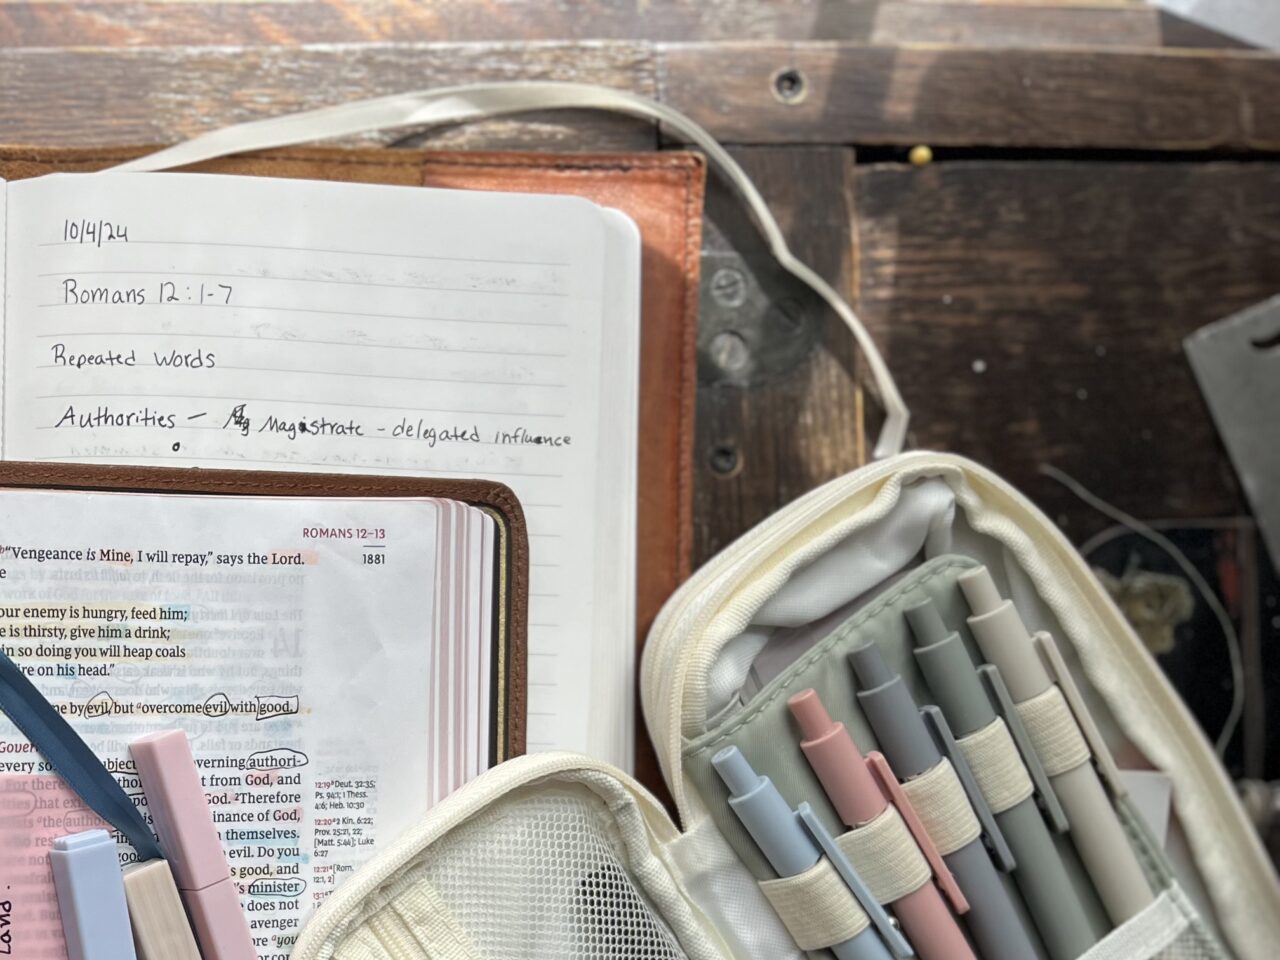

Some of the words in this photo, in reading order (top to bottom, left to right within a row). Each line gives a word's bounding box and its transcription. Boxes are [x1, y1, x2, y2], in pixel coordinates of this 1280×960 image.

[64, 219, 128, 248] 10/4/24
[62, 278, 145, 305] Romans
[51, 343, 136, 369] Repeated
[55, 405, 176, 429] Authorities
[392, 417, 480, 447] delegated
[495, 427, 571, 446] influence
[302, 527, 353, 539] ROMANS
[355, 528, 386, 540] 12–13
[86, 547, 97, 562] is
[99, 548, 134, 565] Mine,
[137, 550, 143, 563] I
[145, 549, 169, 563] will
[171, 550, 214, 567] repay,”
[216, 554, 244, 567] says
[246, 552, 269, 565] the
[271, 552, 305, 566] Lord.
[363, 553, 386, 565] 1881
[22, 607, 68, 622] enemy
[69, 605, 80, 619] is
[81, 605, 129, 623] hungry,
[130, 606, 158, 620] feed
[158, 607, 188, 623] him;
[226, 827, 301, 841] themselves.
[228, 845, 255, 859] evil.
[256, 846, 275, 859] Do
[276, 847, 301, 861] you
[250, 918, 300, 930] avenger
